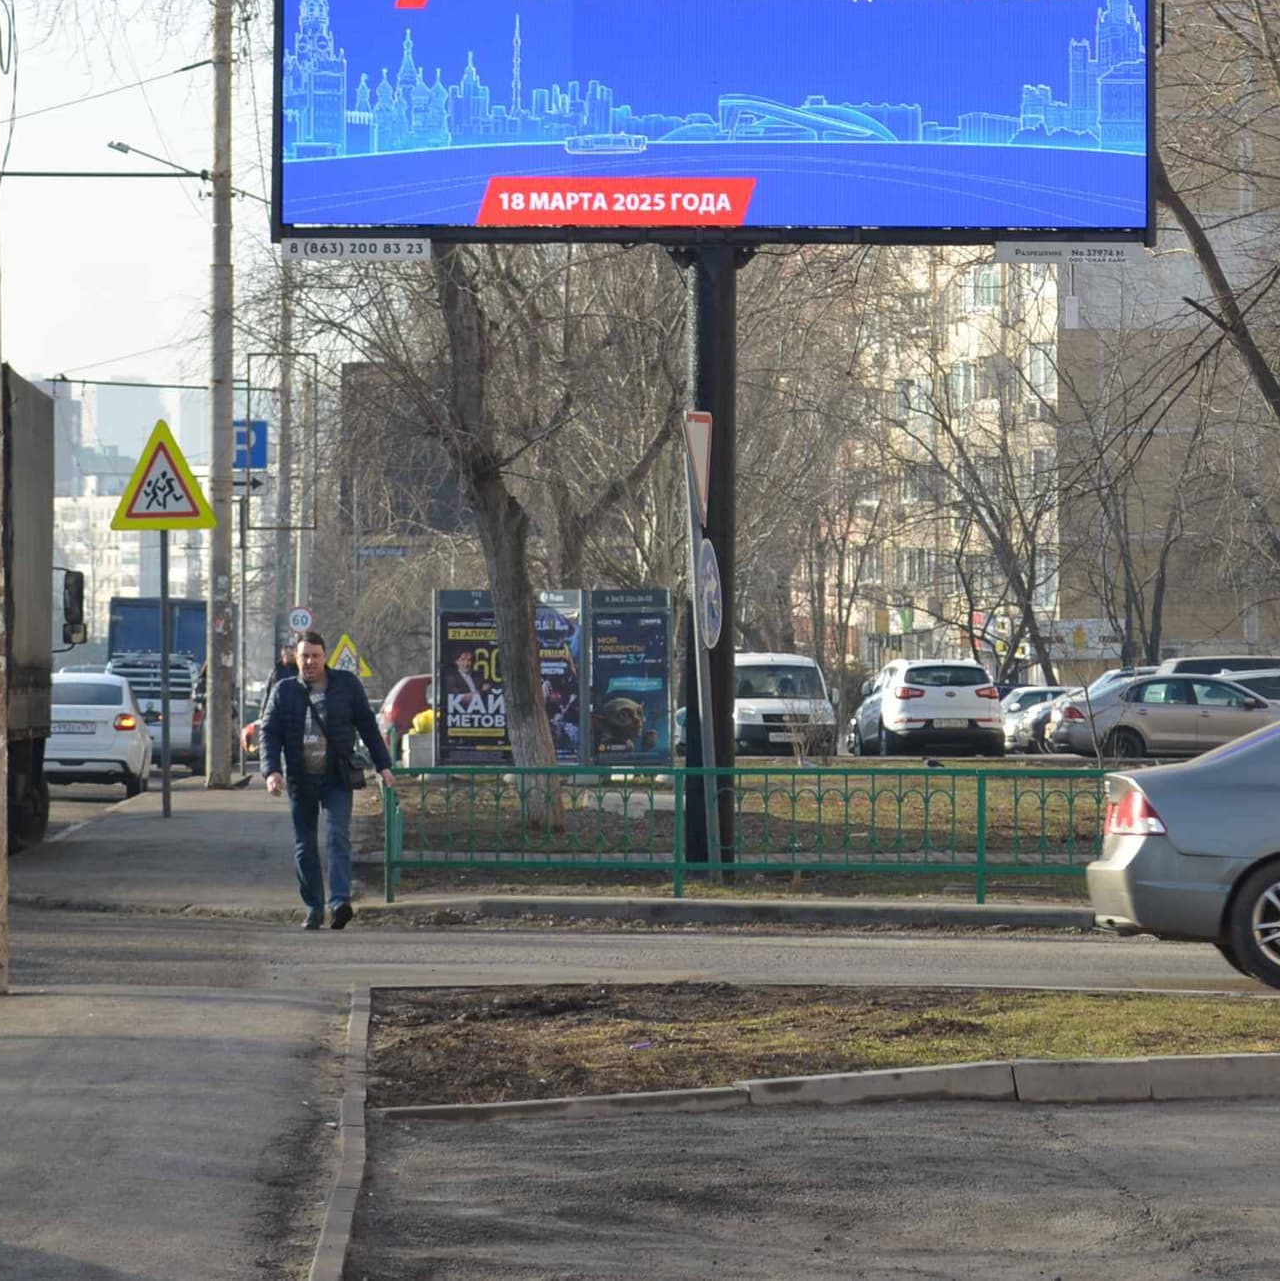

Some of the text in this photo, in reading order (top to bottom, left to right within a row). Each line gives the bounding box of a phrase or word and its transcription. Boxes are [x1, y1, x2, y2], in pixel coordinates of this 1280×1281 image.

[498, 192, 732, 215] 18 МАРТА 2025 ГОДА
[289, 241, 424, 256] 8 (863) 200 83 23
[292, 614, 309, 625] 60
[451, 629, 497, 639] 21 АПРЕЛ
[447, 688, 506, 714] КАЙ
[447, 715, 506, 728] МЕТОВ
